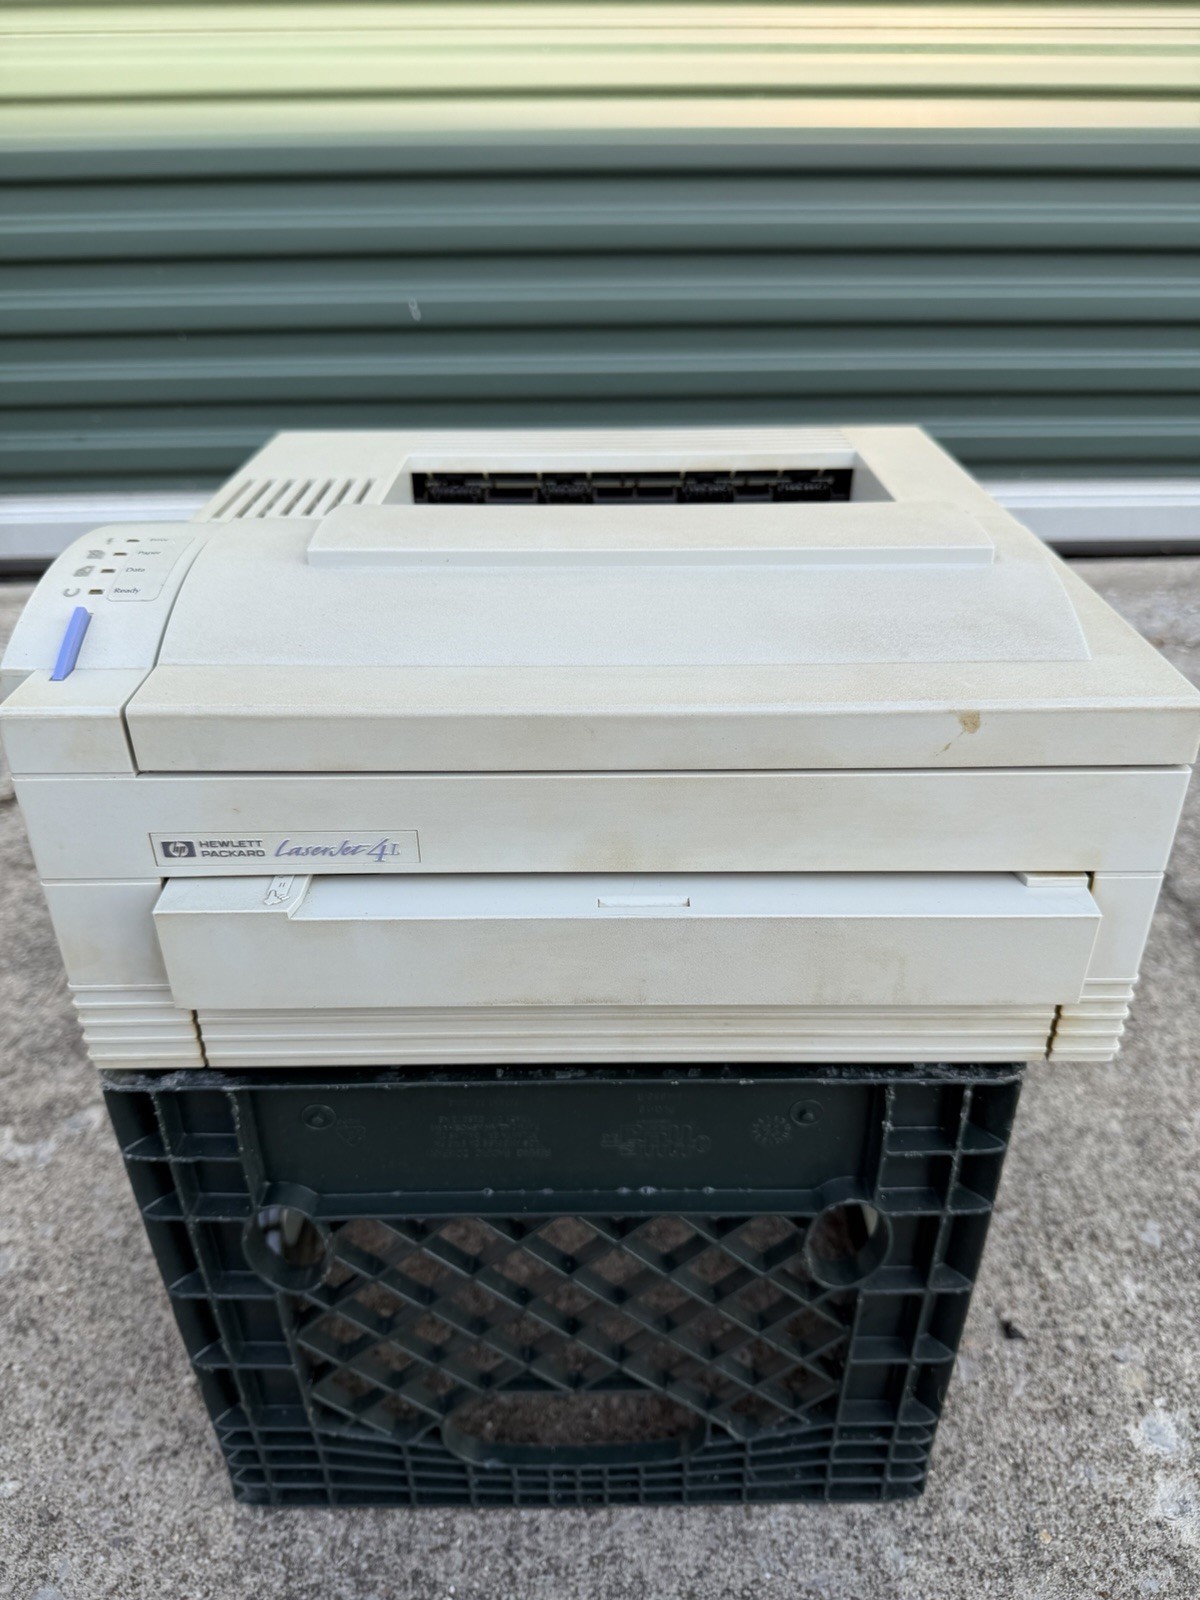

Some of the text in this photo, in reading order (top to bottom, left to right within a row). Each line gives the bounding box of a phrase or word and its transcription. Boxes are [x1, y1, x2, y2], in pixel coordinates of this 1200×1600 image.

[199, 840, 263, 848] HEWLETT
[274, 839, 370, 857] LaserJet
[201, 849, 266, 858] PACKARD
